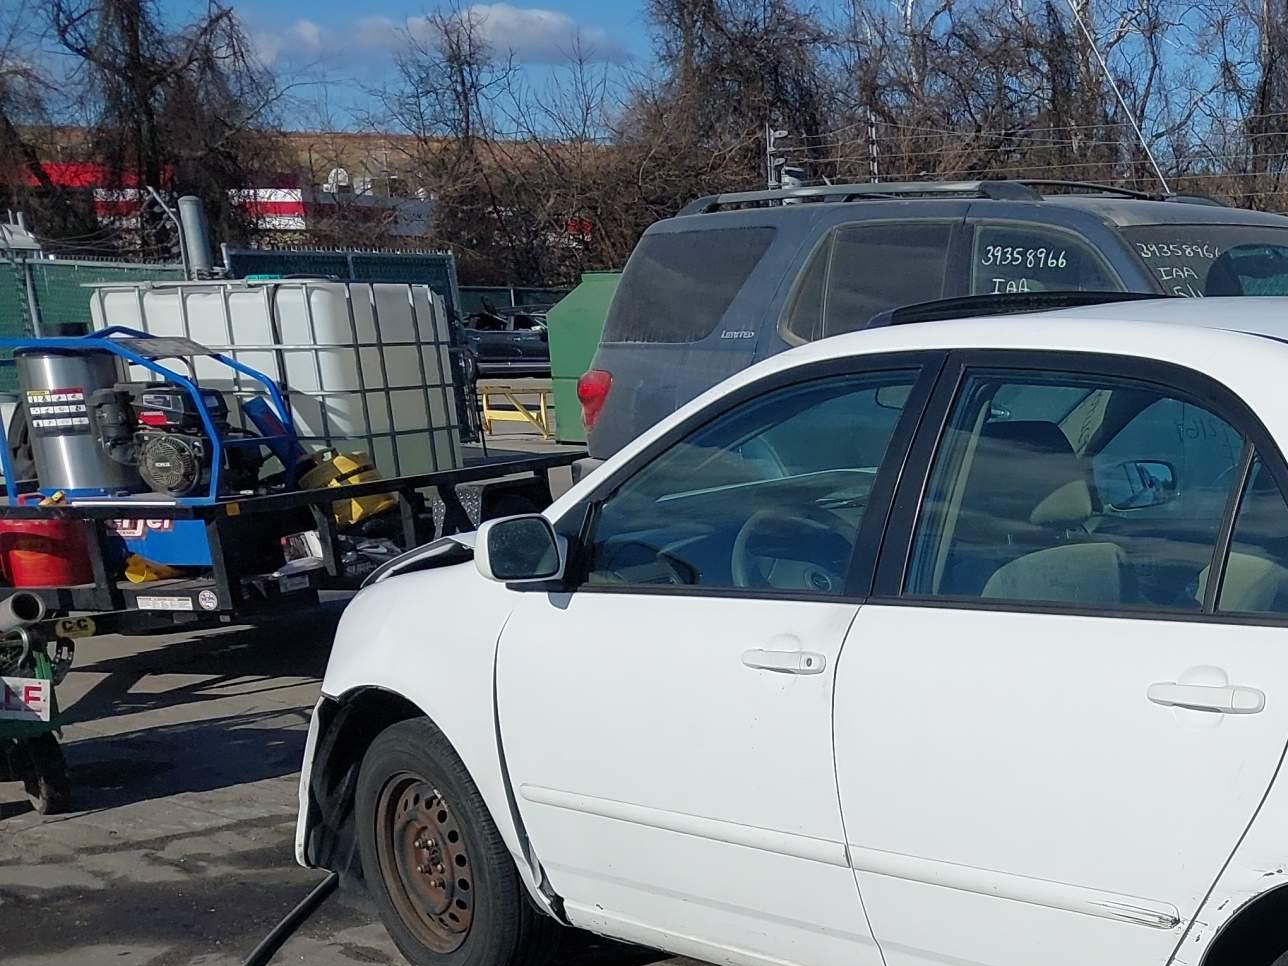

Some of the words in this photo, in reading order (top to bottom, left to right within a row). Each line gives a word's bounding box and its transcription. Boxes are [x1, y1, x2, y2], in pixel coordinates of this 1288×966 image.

[981, 245, 1067, 268] 39358966
[1156, 266, 1198, 281] IAA
[992, 277, 1031, 294] IAA
